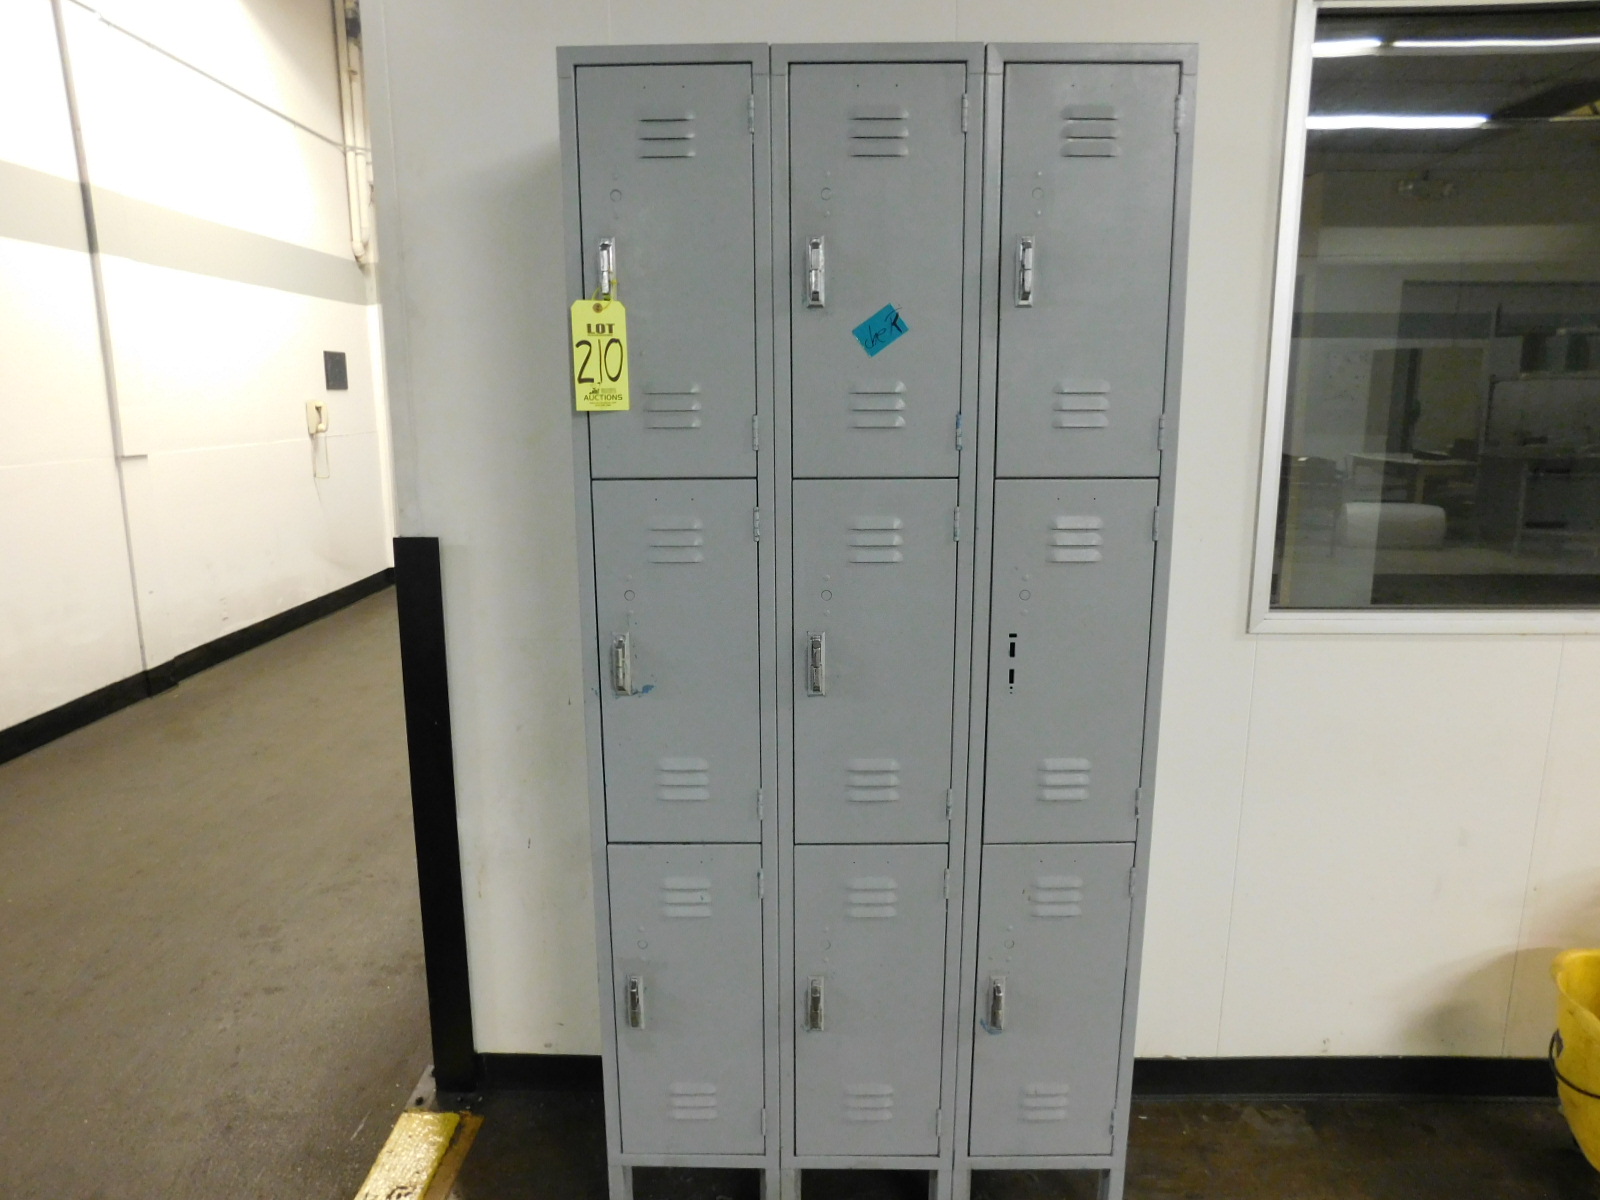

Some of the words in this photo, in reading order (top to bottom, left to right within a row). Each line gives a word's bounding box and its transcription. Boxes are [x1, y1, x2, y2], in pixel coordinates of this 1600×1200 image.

[586, 323, 615, 335] LOT
[575, 338, 624, 384] 210
[583, 393, 623, 401] AUCTIONS
